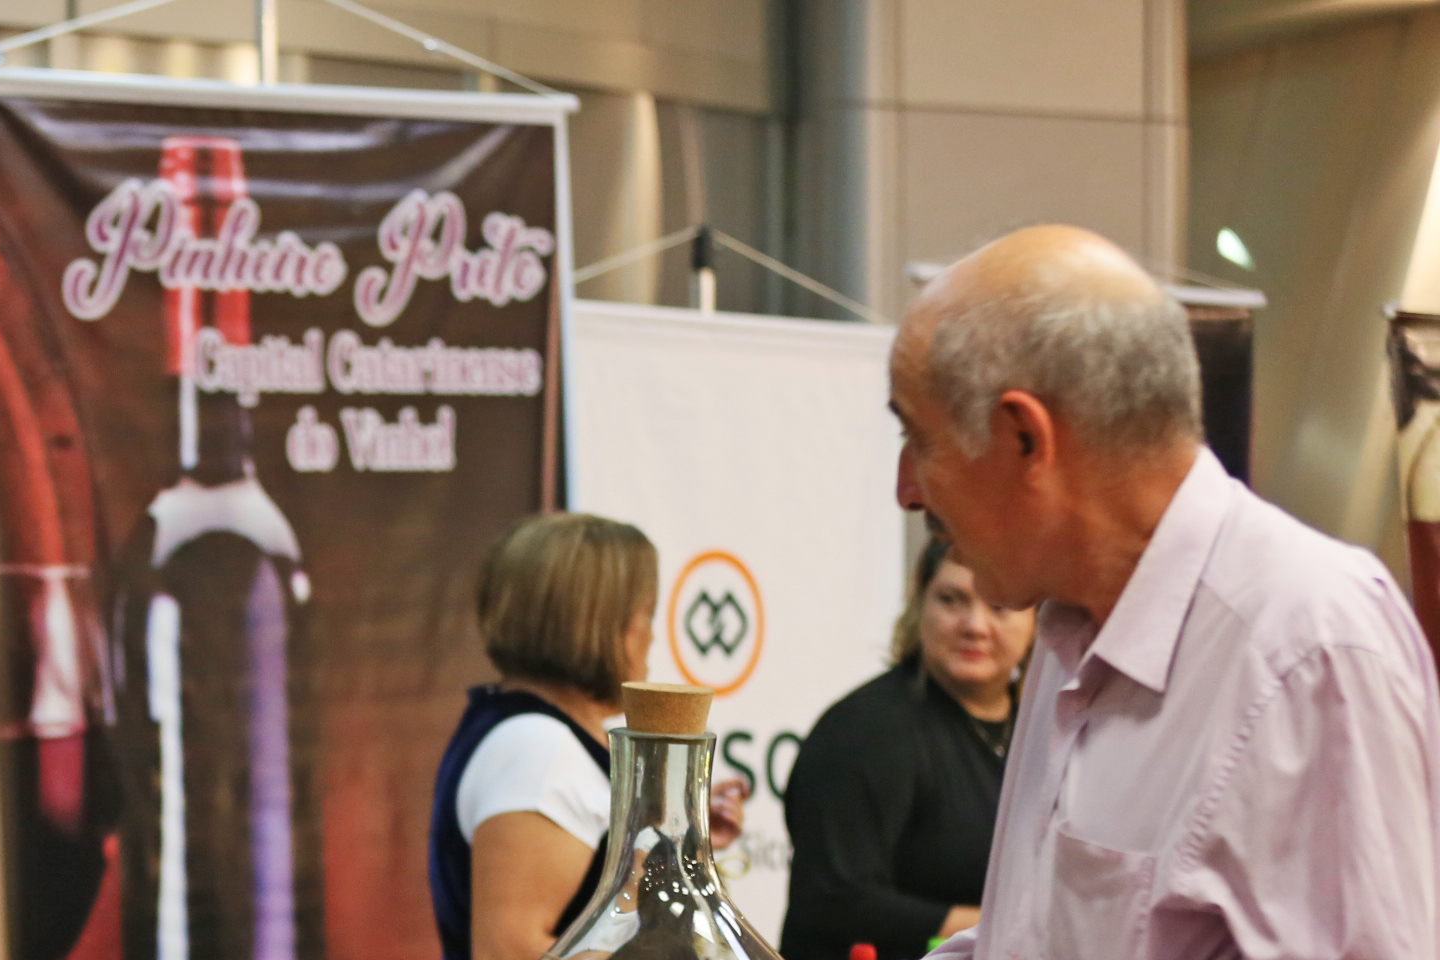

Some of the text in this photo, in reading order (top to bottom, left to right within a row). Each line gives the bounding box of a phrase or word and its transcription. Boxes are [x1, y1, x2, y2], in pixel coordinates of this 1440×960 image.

[62, 177, 347, 321] Pinheiro
[197, 326, 543, 407] Capital Catarinense
